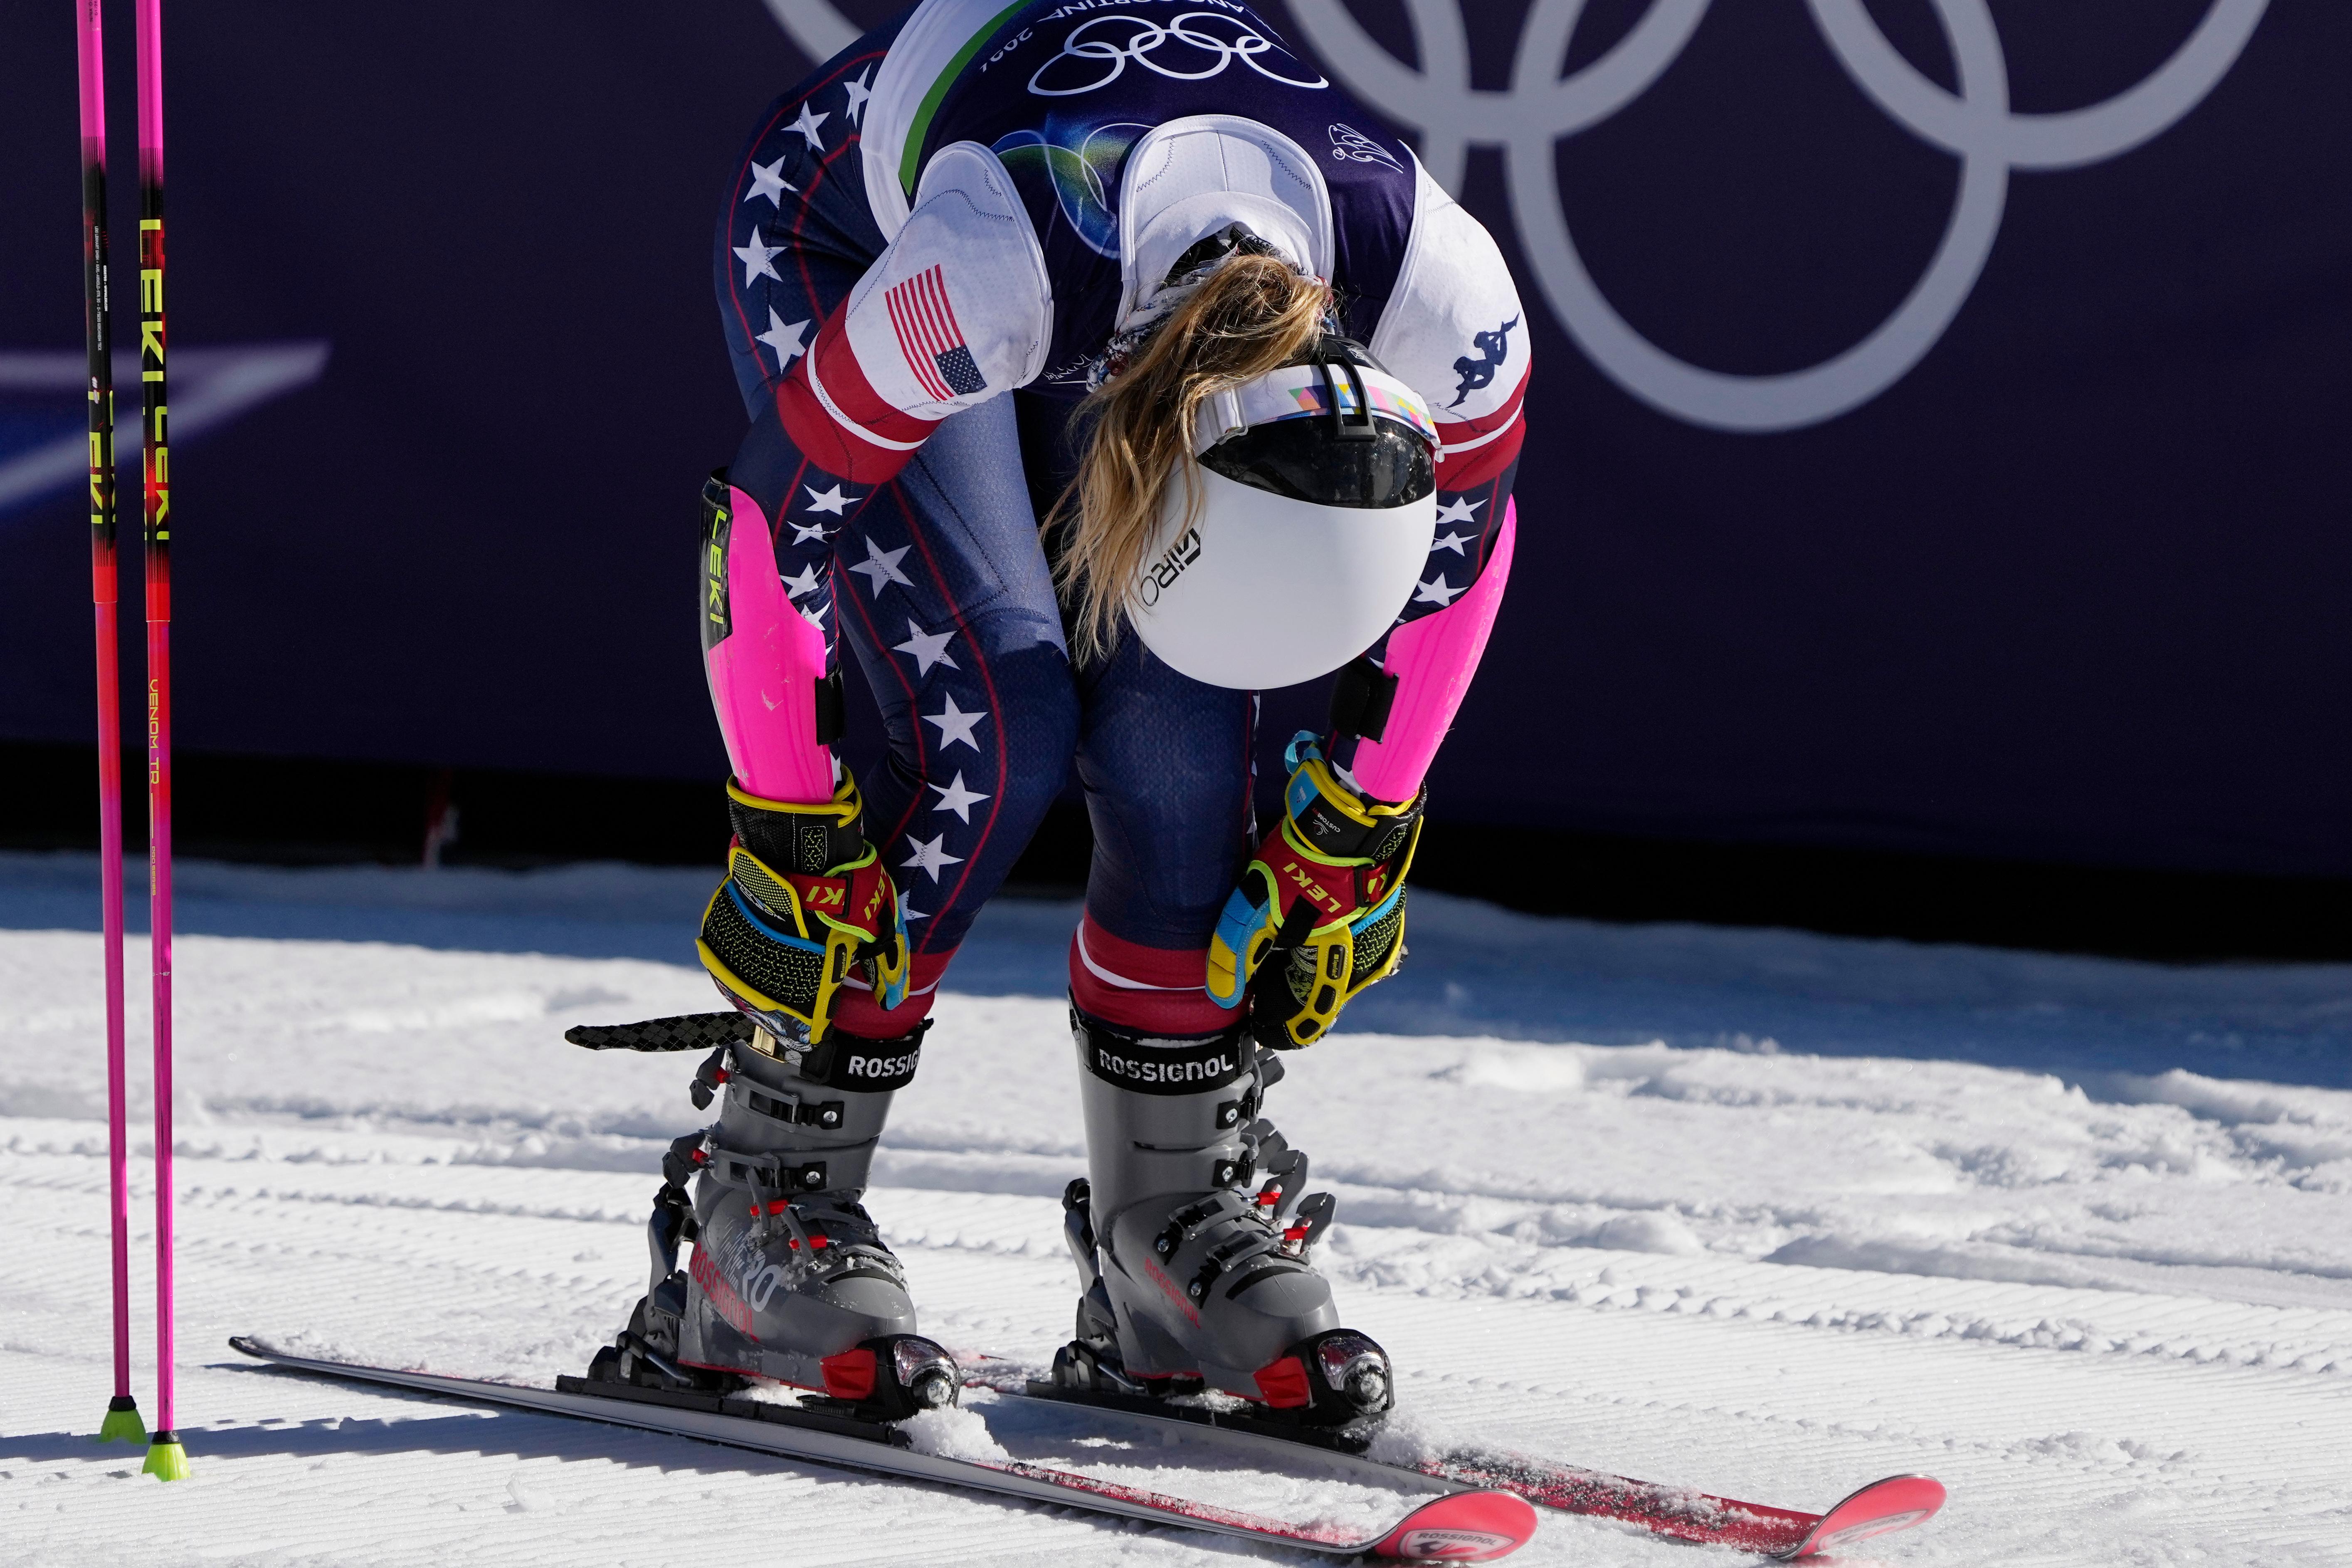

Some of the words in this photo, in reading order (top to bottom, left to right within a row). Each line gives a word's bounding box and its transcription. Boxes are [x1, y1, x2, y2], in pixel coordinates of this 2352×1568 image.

[140, 219, 164, 382] LEKI
[709, 509, 728, 624] LEKI
[1140, 528, 1201, 606] GIRO
[149, 679, 159, 749] VENOM
[150, 757, 160, 784] TR
[1283, 862, 1342, 913] LEKI
[848, 1045, 921, 1077] ROSSIG
[1099, 1048, 1234, 1082] ROSSIGNOL
[689, 1240, 760, 1343] ROSSIGNOL
[1144, 1256, 1202, 1329] ROSSIGNOL
[1418, 1533, 1497, 1546] ROSSIGNOL
